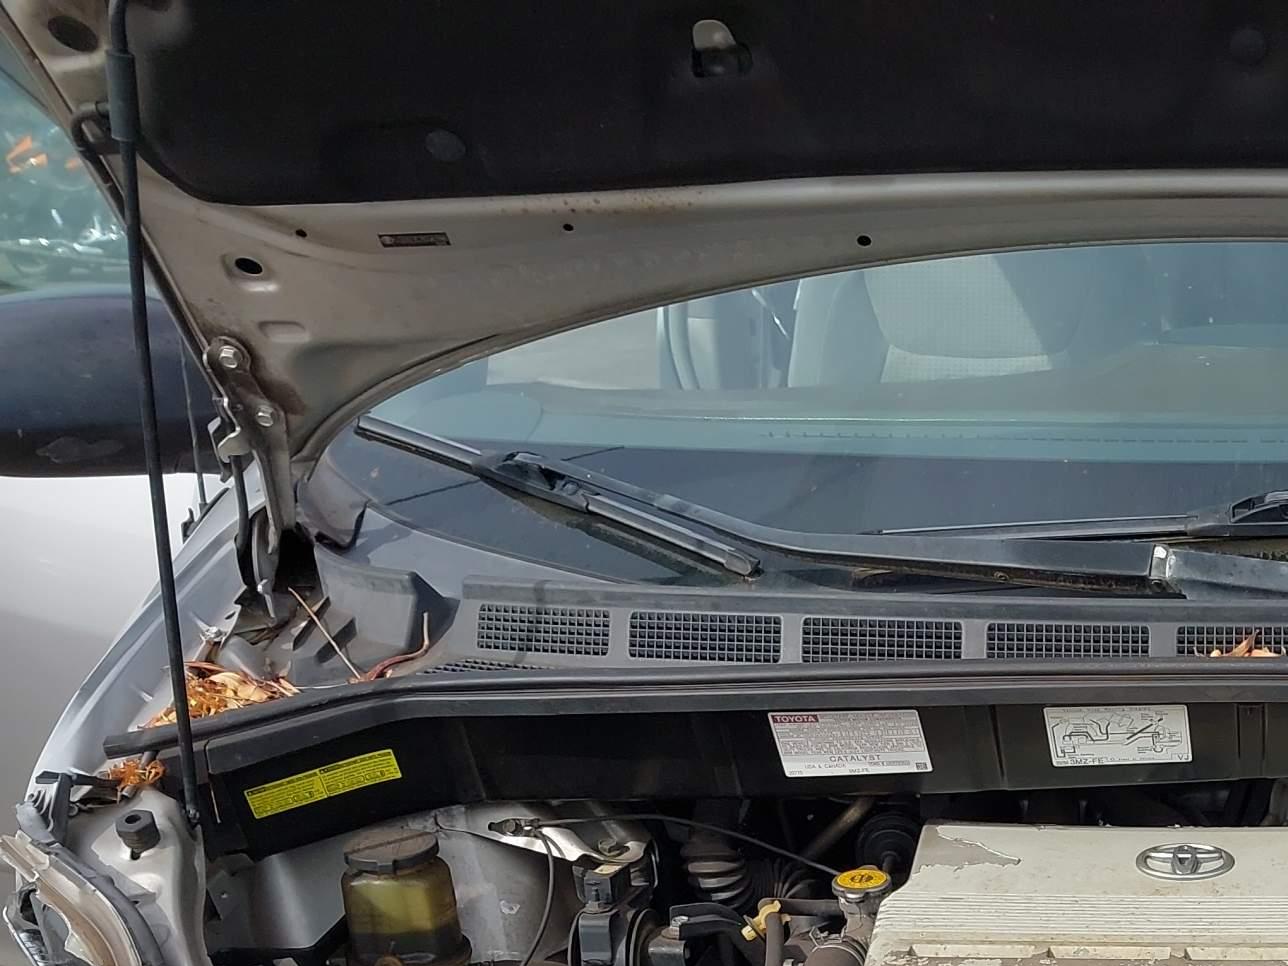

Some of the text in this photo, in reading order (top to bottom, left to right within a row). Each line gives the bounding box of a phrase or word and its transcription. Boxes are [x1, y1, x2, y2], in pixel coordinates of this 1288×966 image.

[773, 715, 817, 723] TOYOTA
[829, 754, 881, 763] CATALYST
[1070, 757, 1105, 765] 3MZ-FE
